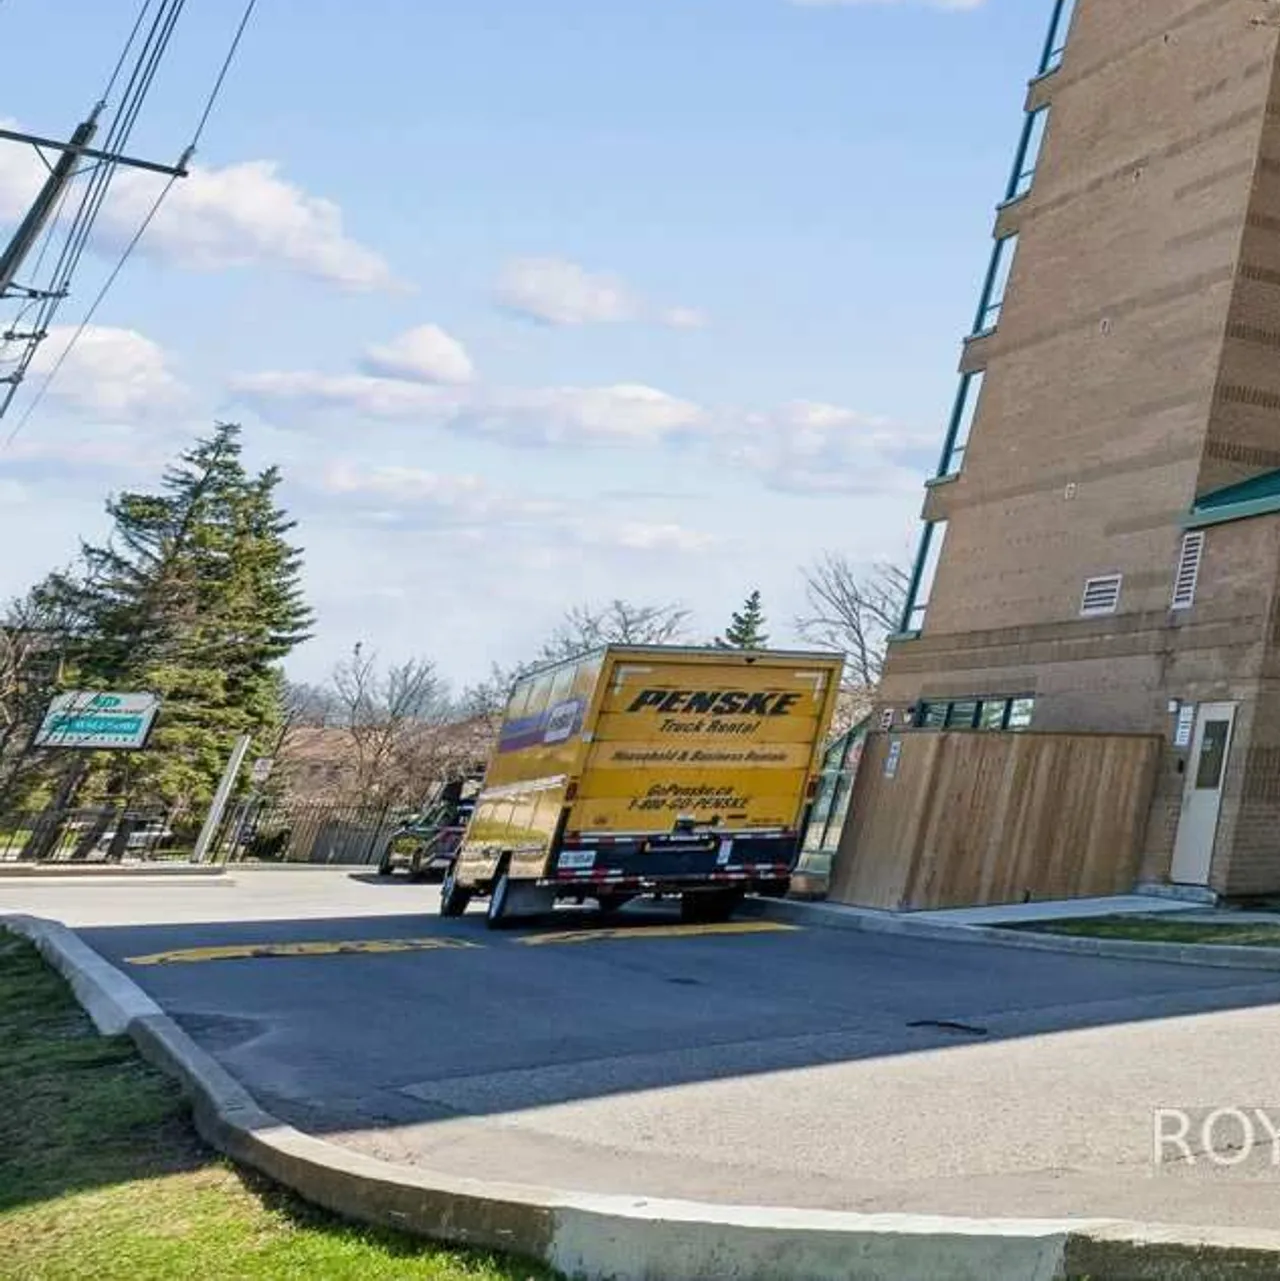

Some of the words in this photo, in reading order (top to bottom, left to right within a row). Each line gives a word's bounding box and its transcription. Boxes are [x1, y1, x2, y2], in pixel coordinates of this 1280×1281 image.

[626, 689, 802, 716] PENSKE
[660, 719, 703, 733] Truck
[706, 719, 761, 735] Rental
